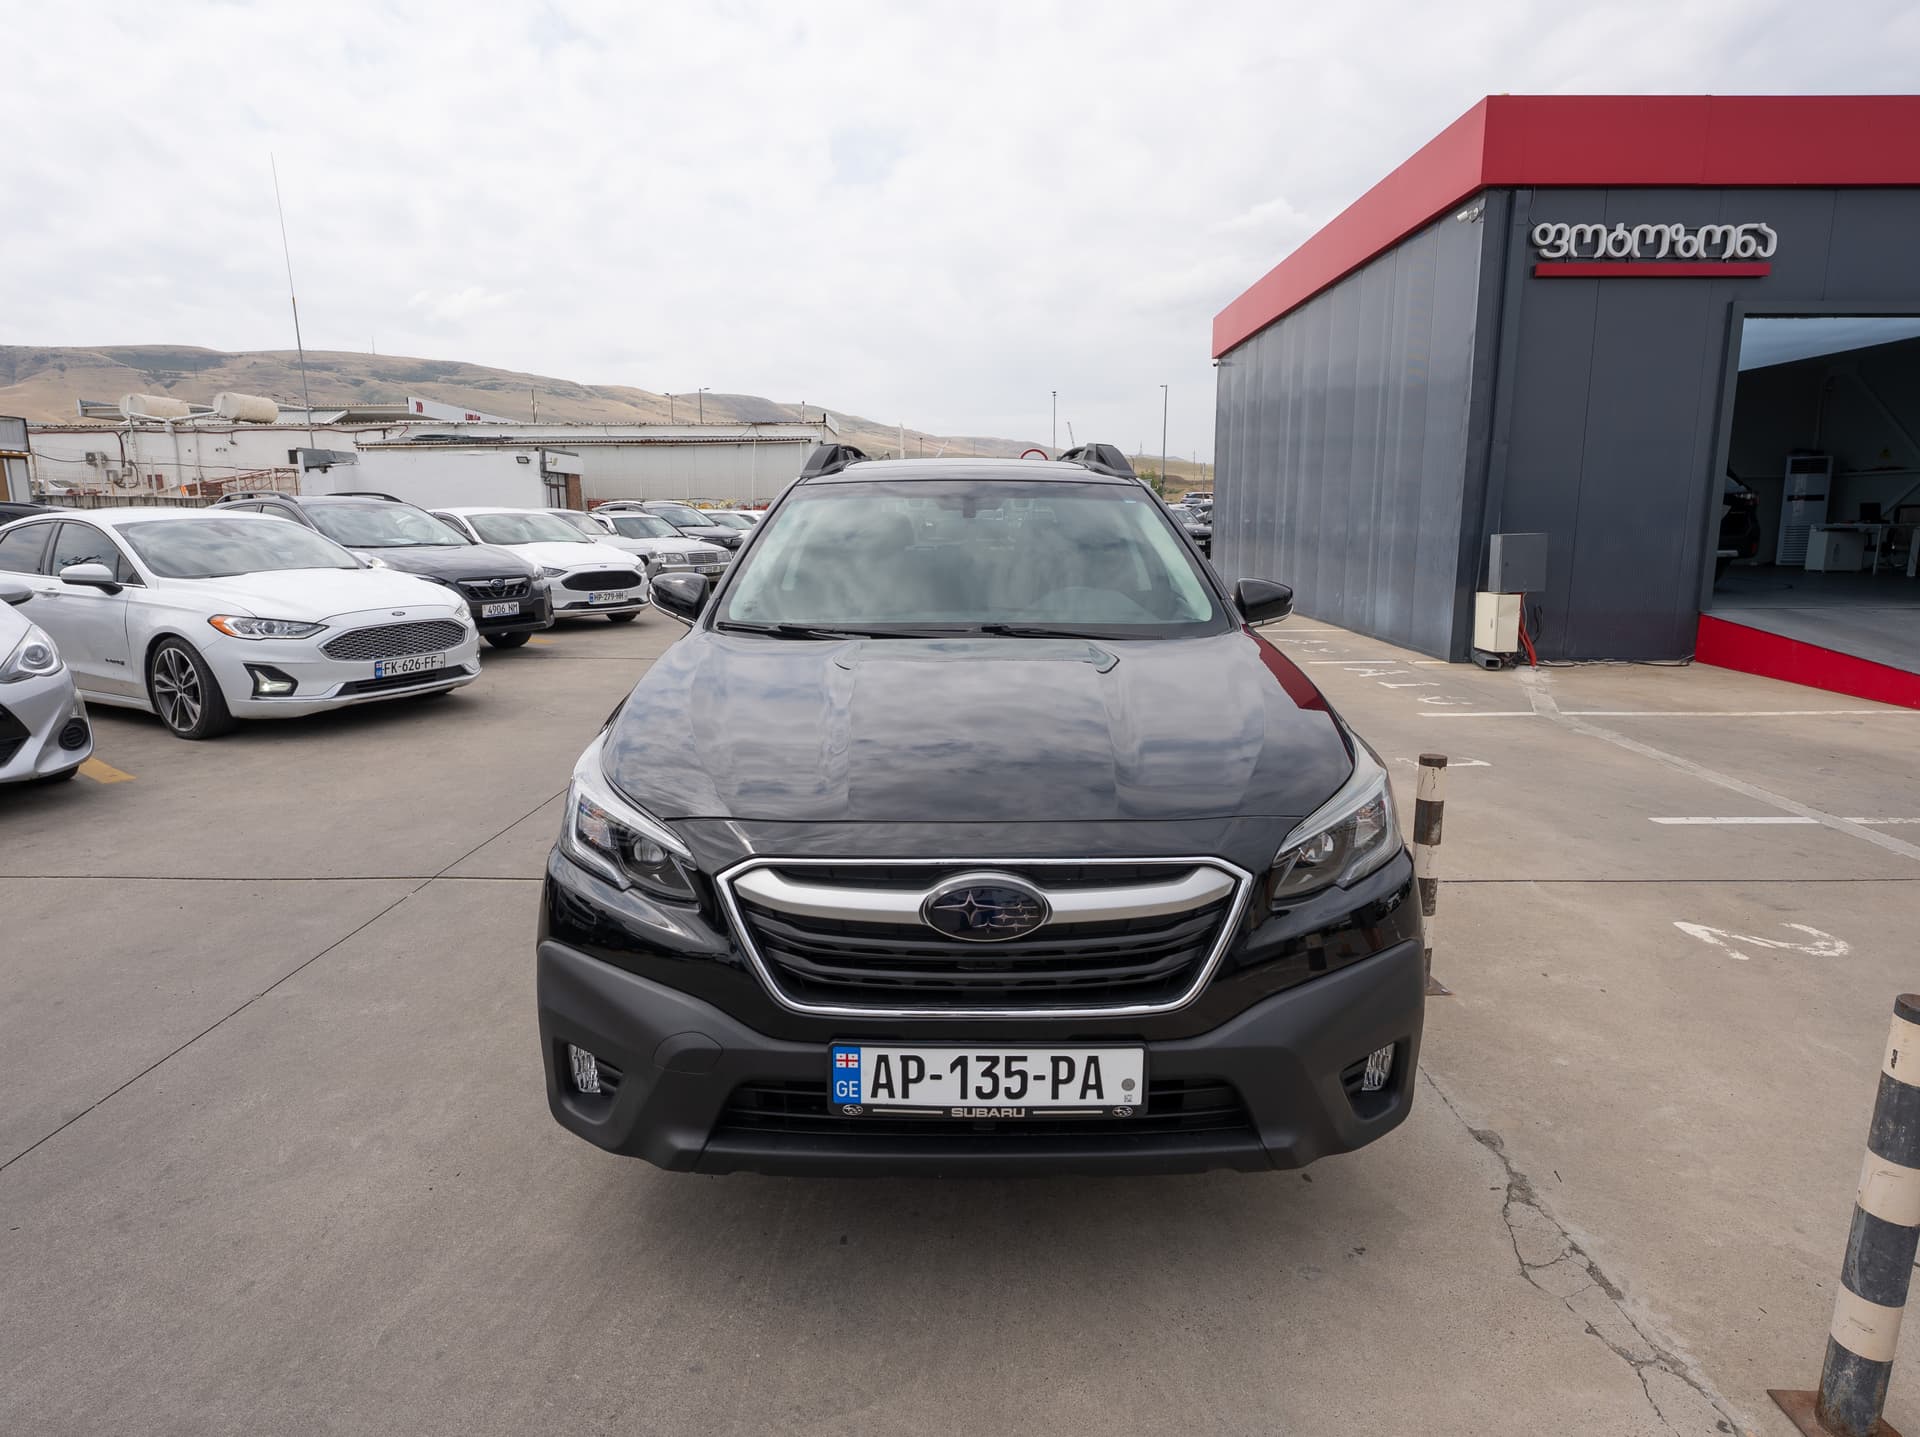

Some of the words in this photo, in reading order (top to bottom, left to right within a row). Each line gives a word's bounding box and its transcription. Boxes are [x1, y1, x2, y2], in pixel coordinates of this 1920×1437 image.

[1532, 222, 1778, 259] ფოტოზონა
[384, 655, 437, 675] FK-626-FF
[836, 1080, 859, 1098] GE
[870, 1053, 1105, 1101] AP-135-PA
[951, 1107, 1026, 1118] SUBARU
